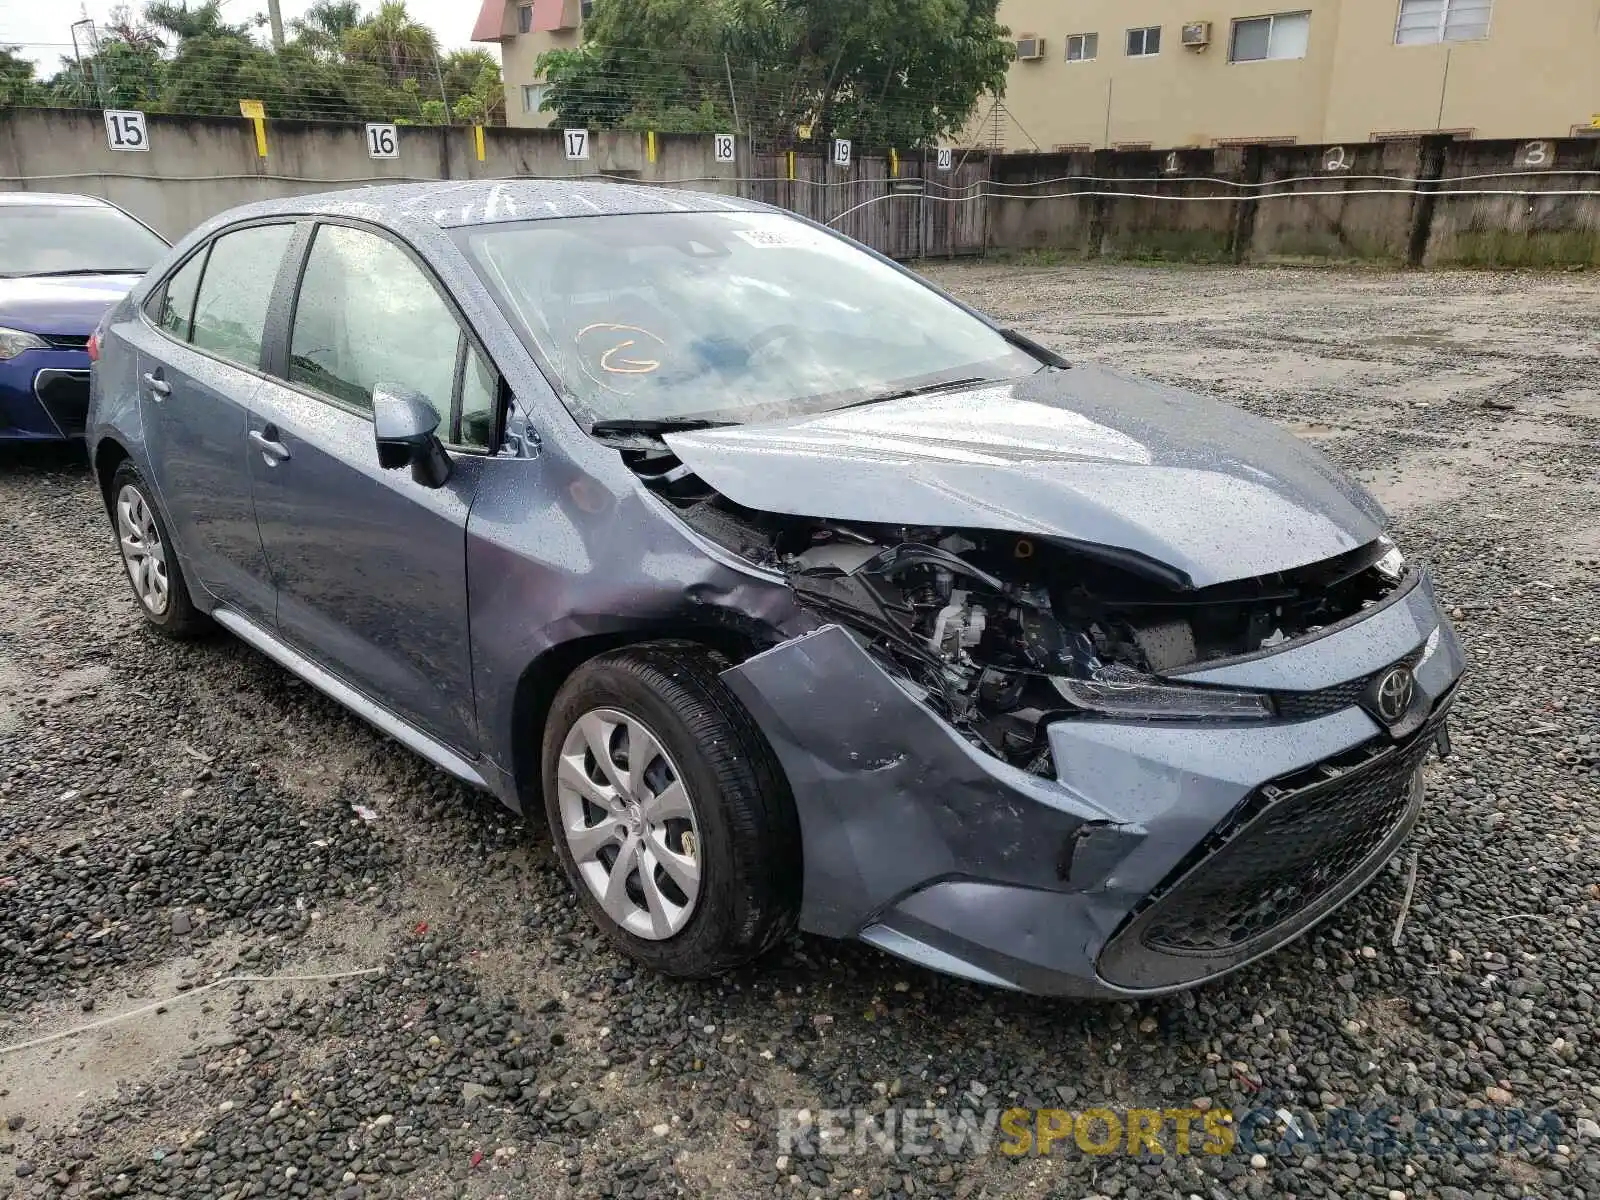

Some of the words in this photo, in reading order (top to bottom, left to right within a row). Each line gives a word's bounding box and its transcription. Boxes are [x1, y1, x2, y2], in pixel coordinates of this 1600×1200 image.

[110, 115, 142, 145] 15
[370, 128, 394, 153] 16
[567, 133, 585, 155] 17
[717, 138, 732, 158] 18
[836, 142, 849, 161] 19
[1525, 140, 1545, 164] 3
[939, 150, 950, 167] 20
[1166, 151, 1178, 172] 1
[1325, 146, 1350, 170] 2
